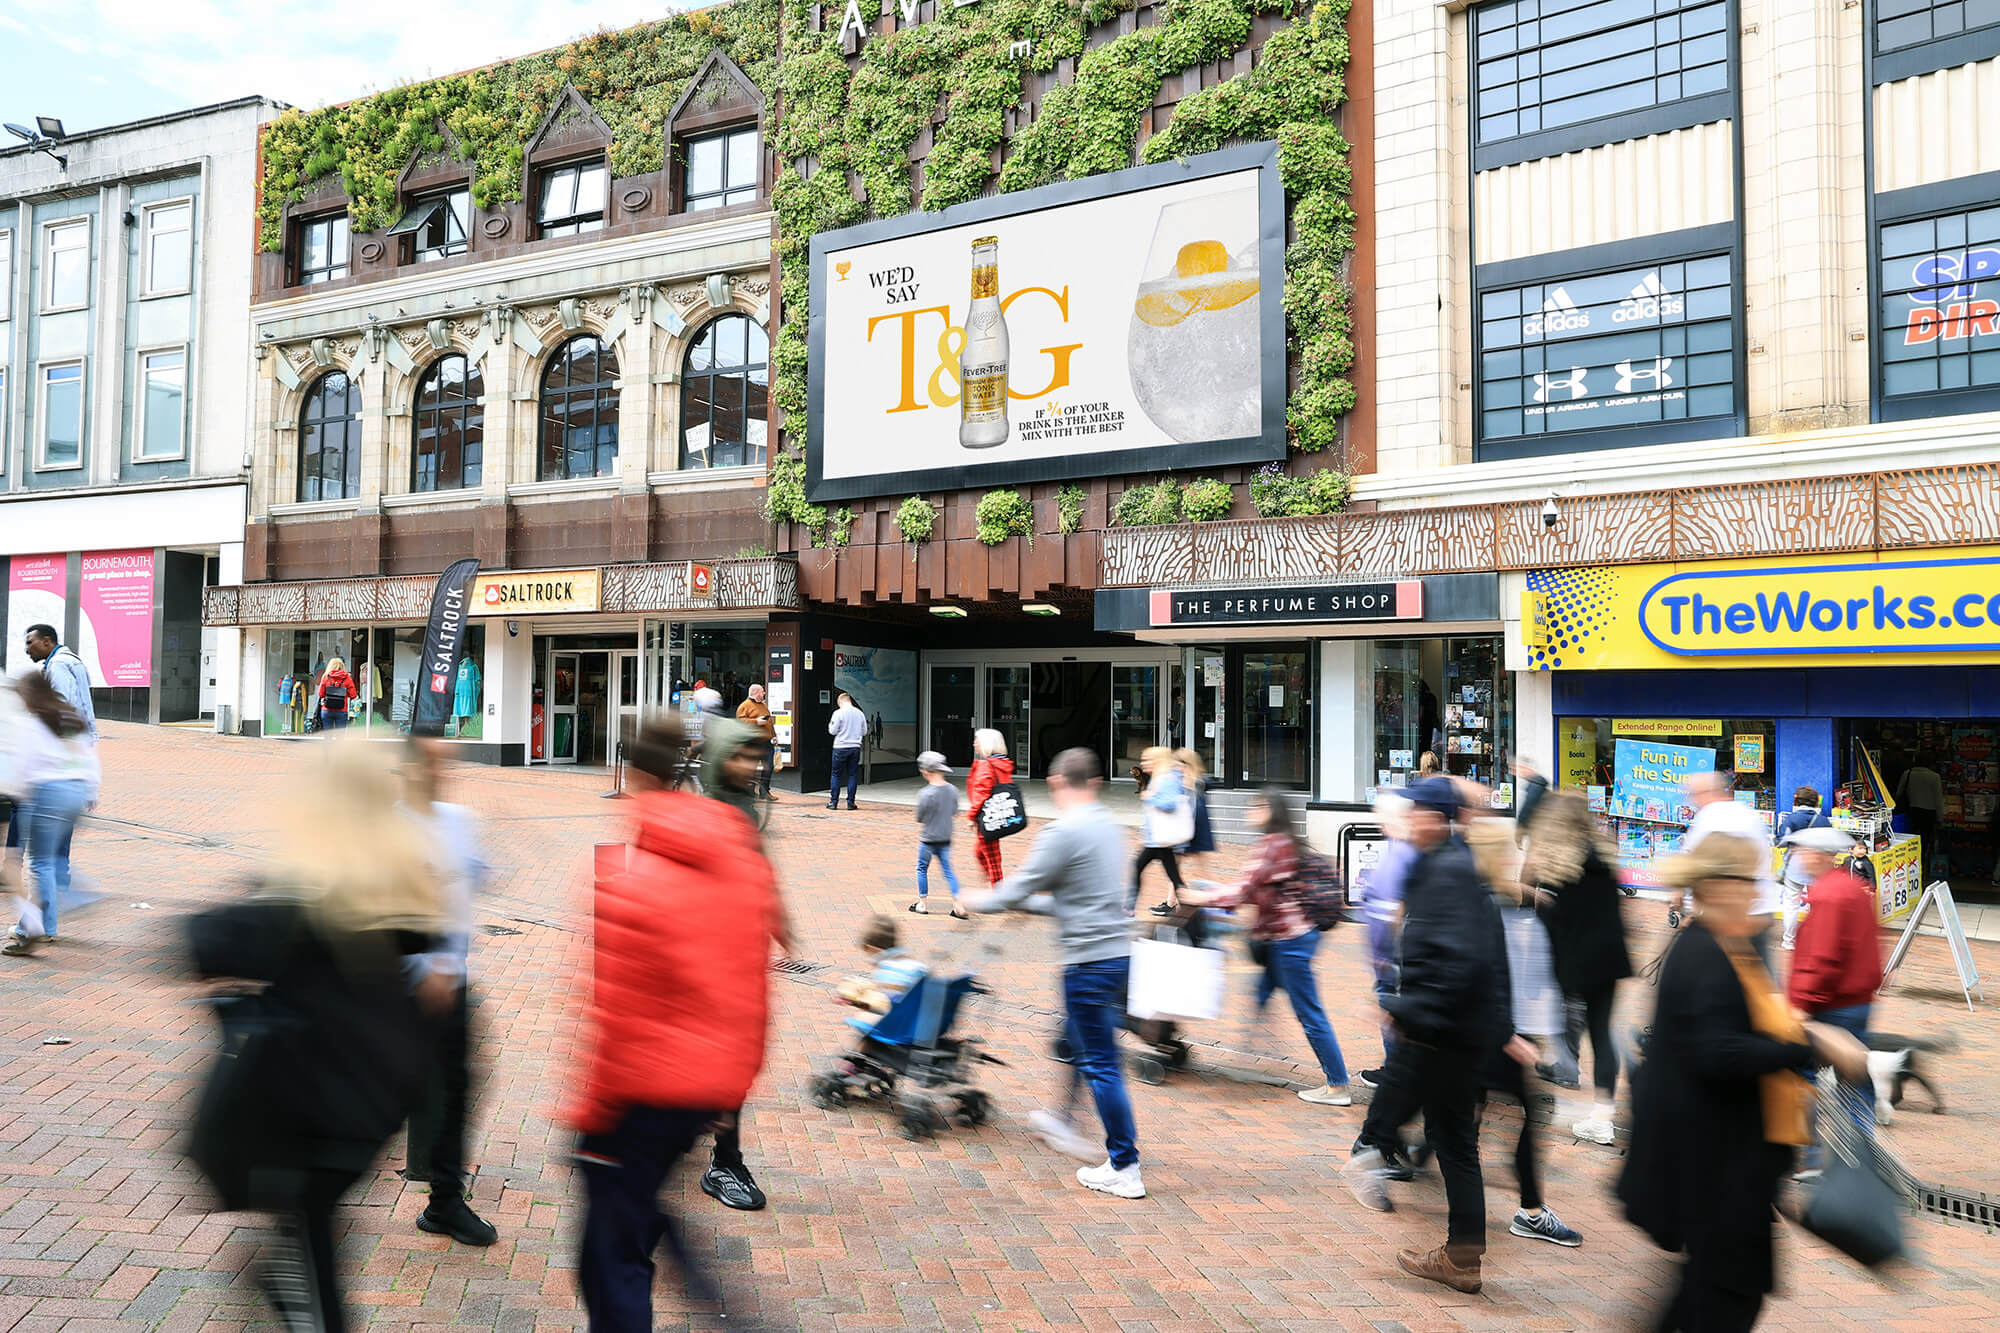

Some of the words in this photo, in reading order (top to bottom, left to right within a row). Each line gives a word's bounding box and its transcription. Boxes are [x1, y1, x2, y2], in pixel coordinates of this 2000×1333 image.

[869, 266, 914, 288] WE'D
[886, 284, 920, 304] SAY
[1612, 297, 1683, 323] adidas
[1523, 312, 1590, 335] adidas
[1904, 299, 2000, 345] DIR
[973, 384, 995, 392] TONIC
[973, 391, 995, 399] WATER
[1035, 409, 1046, 419] IF
[1064, 405, 1078, 415] OF
[1080, 402, 1110, 414] YOUR
[1525, 407, 1555, 416] UNDER
[1605, 397, 1638, 407] UNDER
[1019, 419, 1051, 431] DRINK
[1054, 418, 1063, 427] IS
[1065, 414, 1088, 426] THE
[1089, 411, 1125, 424] MIXER
[1022, 430, 1042, 441] MIX
[1044, 427, 1072, 438] WITH
[1074, 424, 1097, 436] THE
[1099, 421, 1125, 433] BEST
[83, 556, 152, 570] BOURNEMOUTH,
[106, 570, 125, 580] place
[500, 582, 574, 602] SALTROCK
[1176, 600, 1211, 614] THE
[1225, 596, 1317, 614] PERFUME
[1331, 594, 1390, 610] SHOP
[434, 587, 464, 673] SALTROCK
[1617, 722, 1655, 731] Extended
[1657, 723, 1684, 733] Range
[1686, 723, 1717, 732] Online!
[1568, 751, 1585, 759] Books
[1640, 748, 1669, 766] Fun
[1672, 751, 1688, 768] in
[1632, 764, 1659, 782] the
[1661, 768, 1693, 785] Sun
[1881, 901, 1892, 915] £10
[1895, 888, 1908, 908] £8
